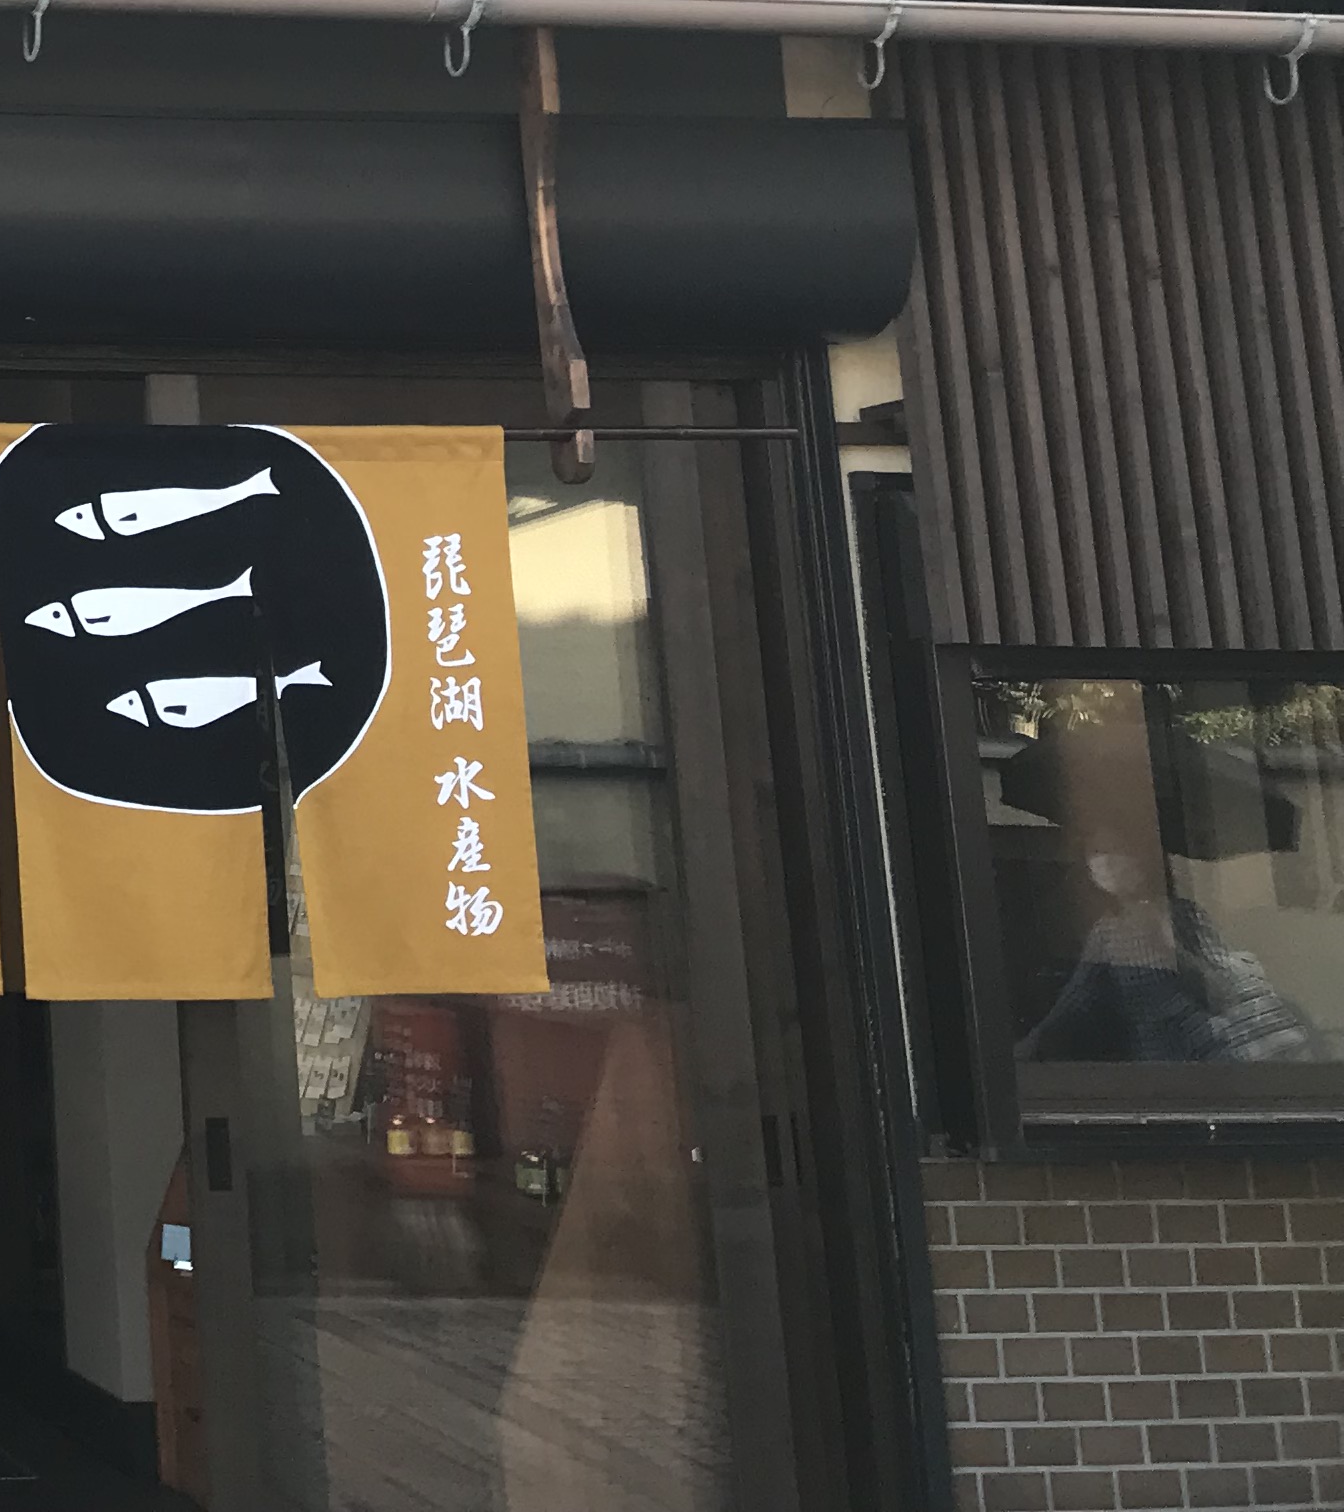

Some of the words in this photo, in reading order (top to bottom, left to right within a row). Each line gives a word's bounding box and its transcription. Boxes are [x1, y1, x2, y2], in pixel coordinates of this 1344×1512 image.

[422, 532, 484, 732] 琵琶湖
[433, 755, 504, 936] 水産物
